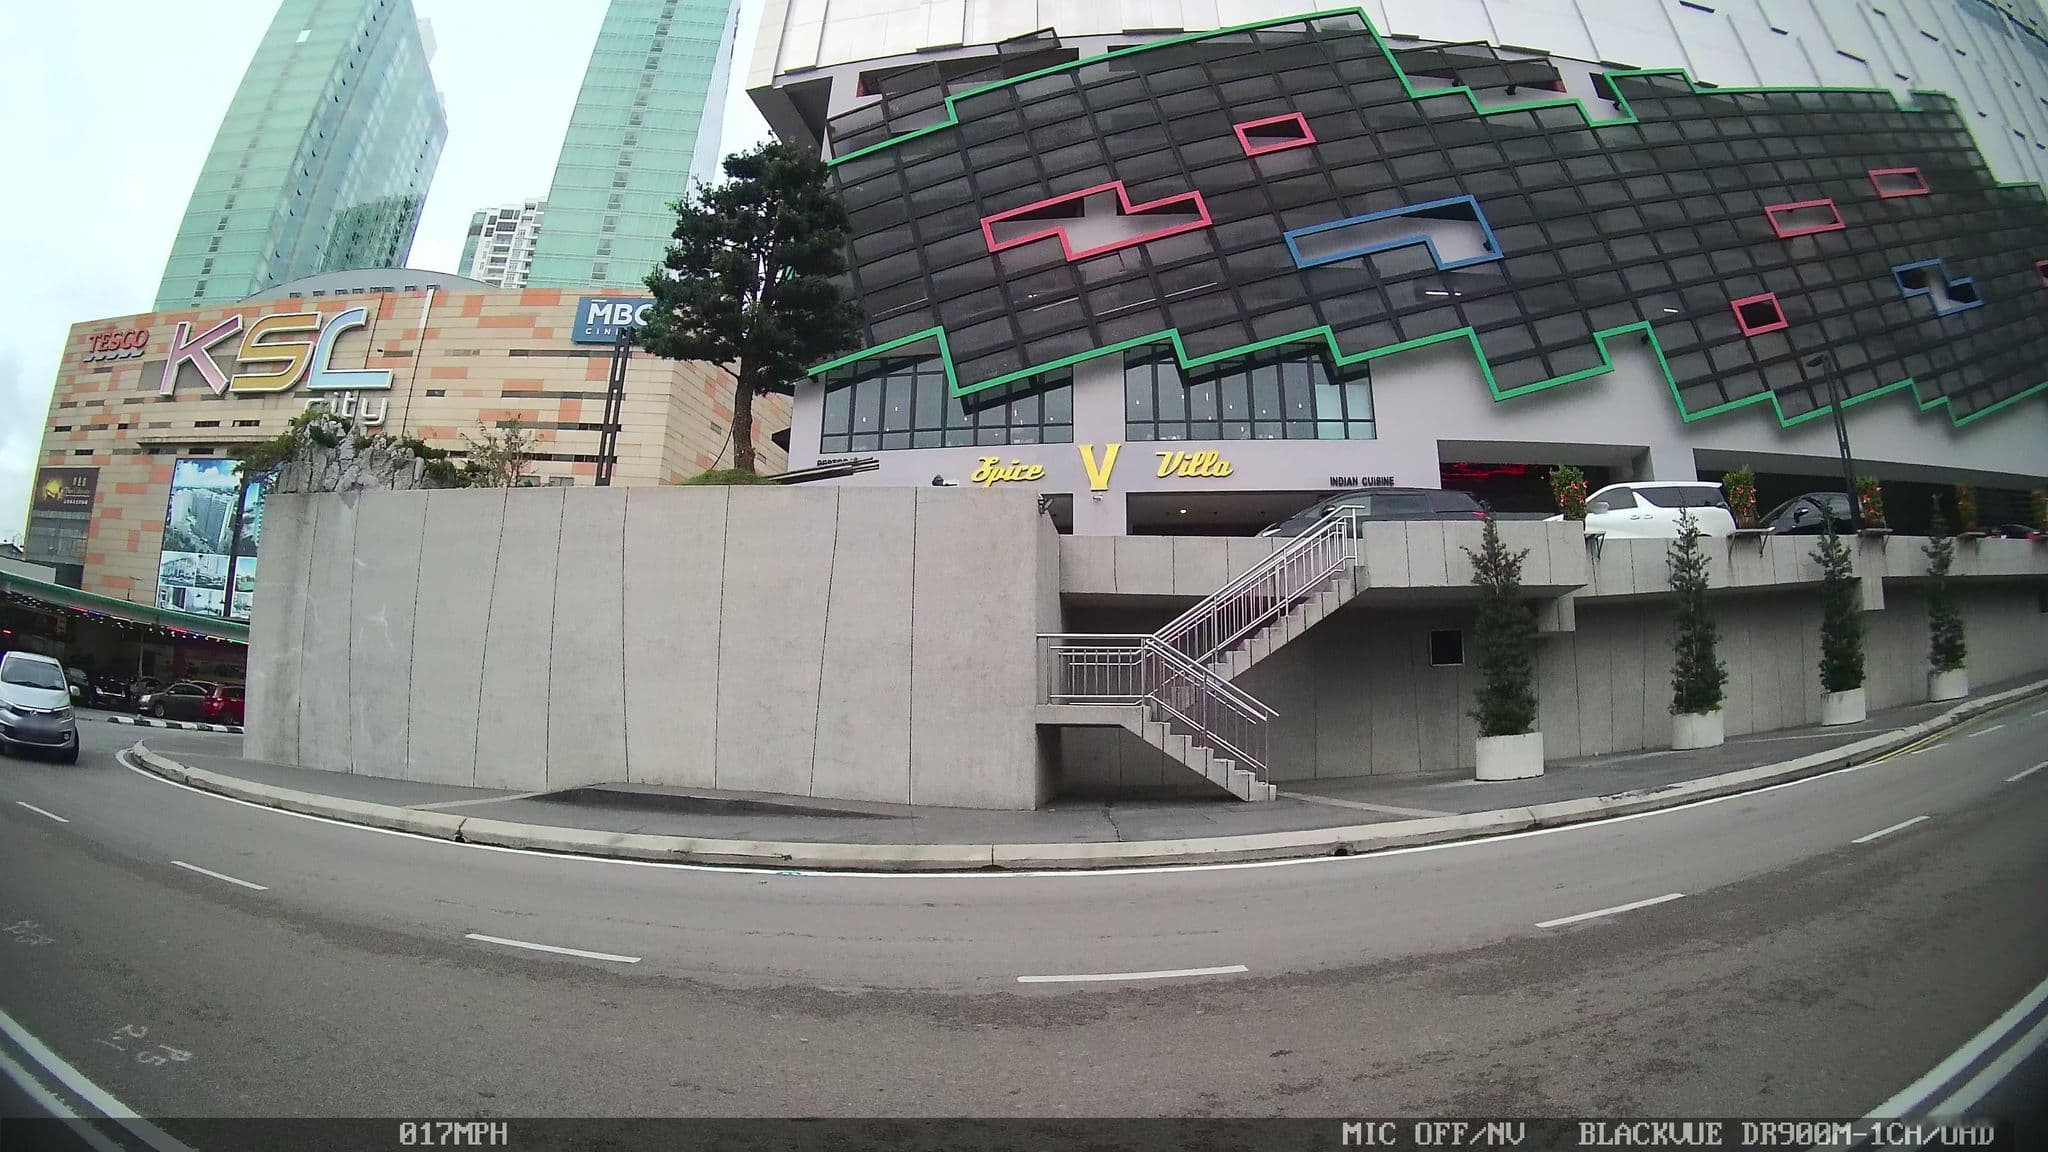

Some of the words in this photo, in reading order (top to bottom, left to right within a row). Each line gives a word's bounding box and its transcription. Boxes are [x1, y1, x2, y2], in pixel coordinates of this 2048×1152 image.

[89, 328, 150, 353] TESCO
[160, 306, 394, 397] KSL
[971, 456, 1045, 488] Spice
[1078, 443, 1122, 491] V
[1156, 450, 1234, 478] Villa
[1329, 476, 1359, 487] INDIAN
[1361, 476, 1395, 487] CUISINE
